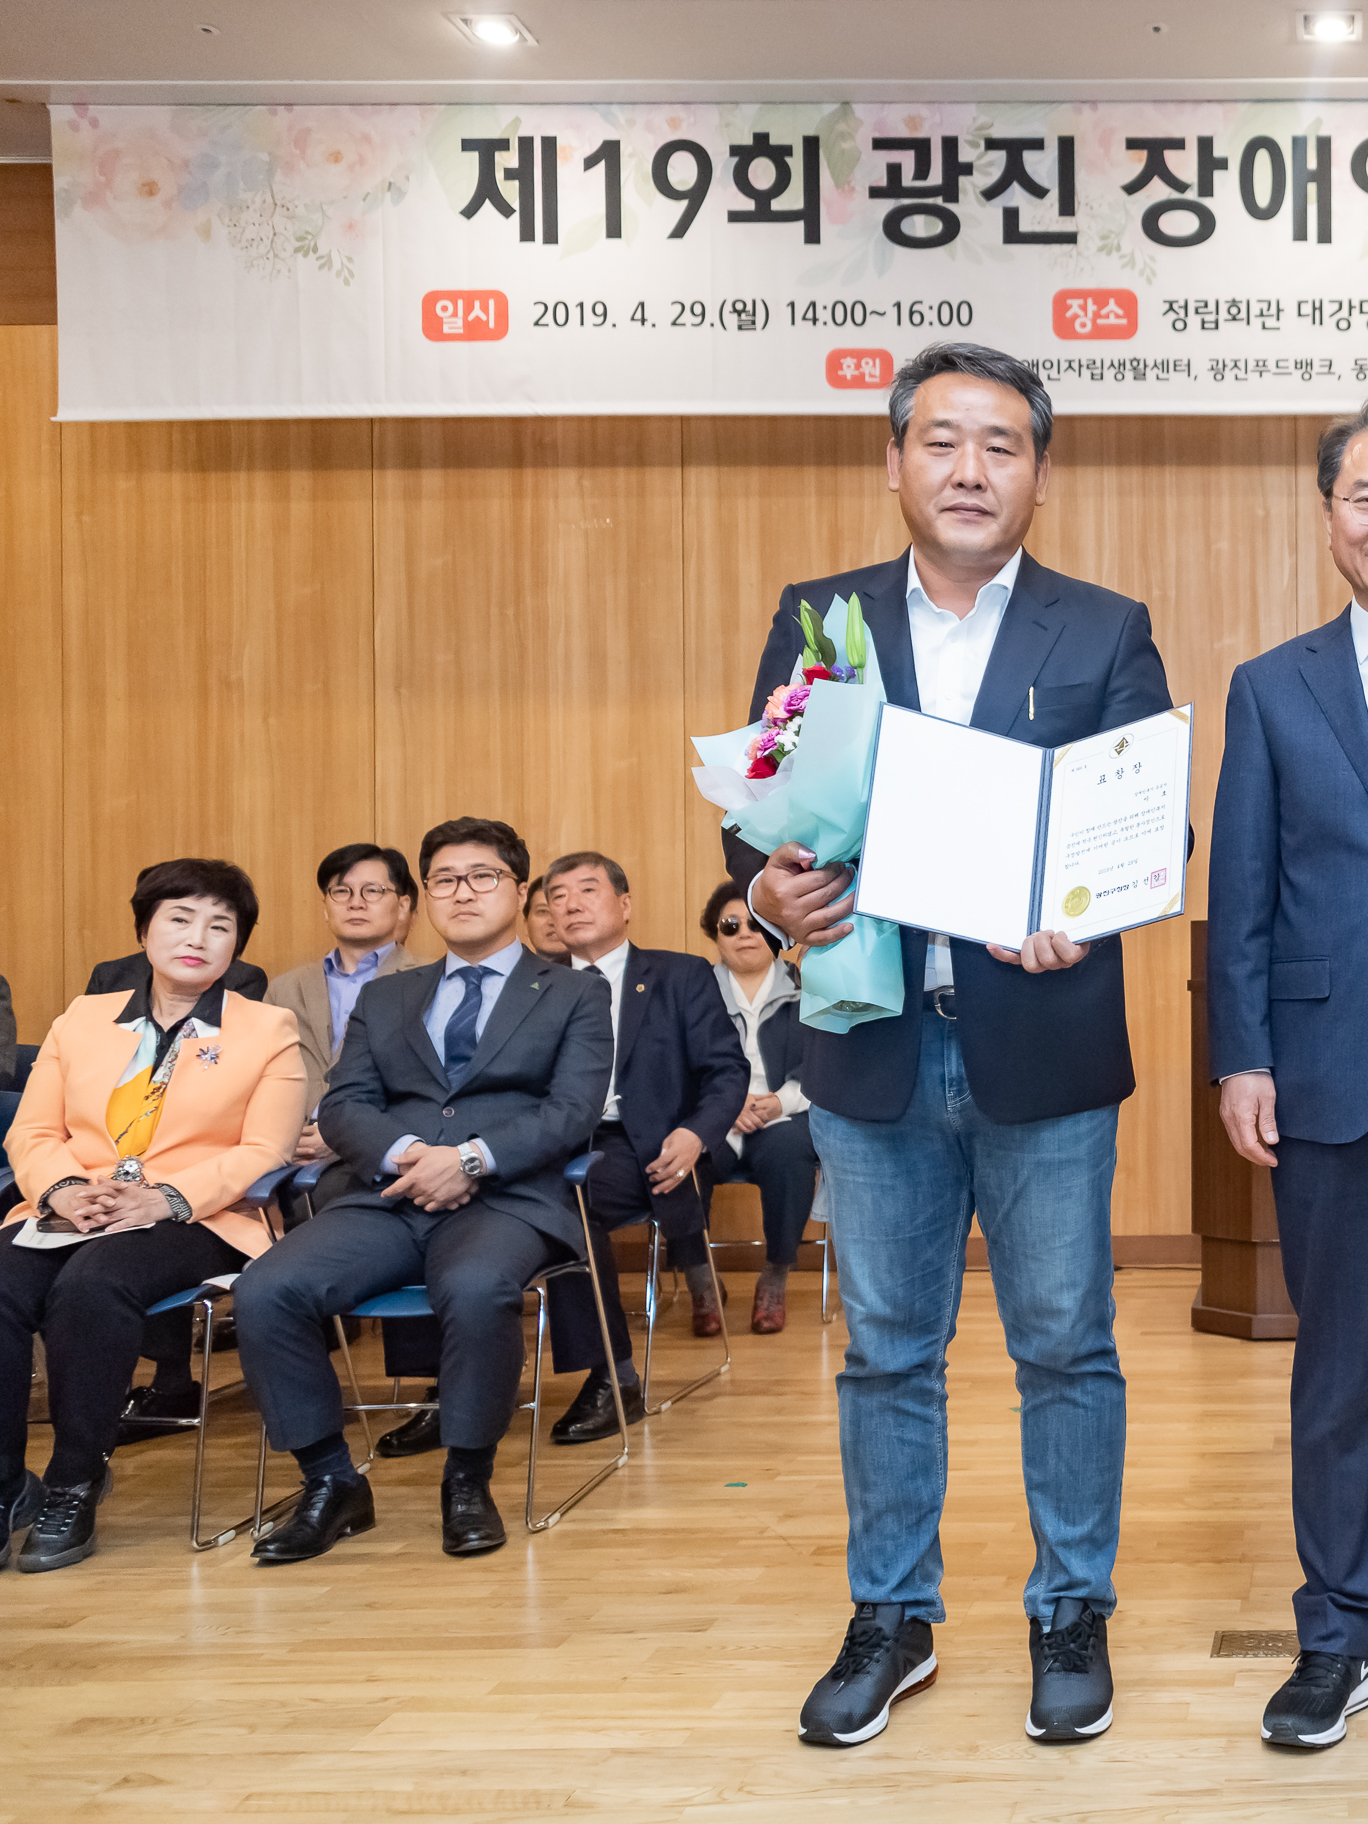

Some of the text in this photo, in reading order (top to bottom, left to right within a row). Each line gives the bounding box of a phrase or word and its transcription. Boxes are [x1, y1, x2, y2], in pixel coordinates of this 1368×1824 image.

[460, 131, 821, 245] 제19회
[868, 135, 1078, 249] 광진
[435, 298, 973, 334] 일시 2019. 4. 29.(월) 14:00~16:00
[1065, 297, 1128, 334] 장소
[1162, 298, 1282, 332] 정립회관
[838, 356, 881, 383] 후원
[1207, 358, 1342, 383] 광진푸드뱅크,
